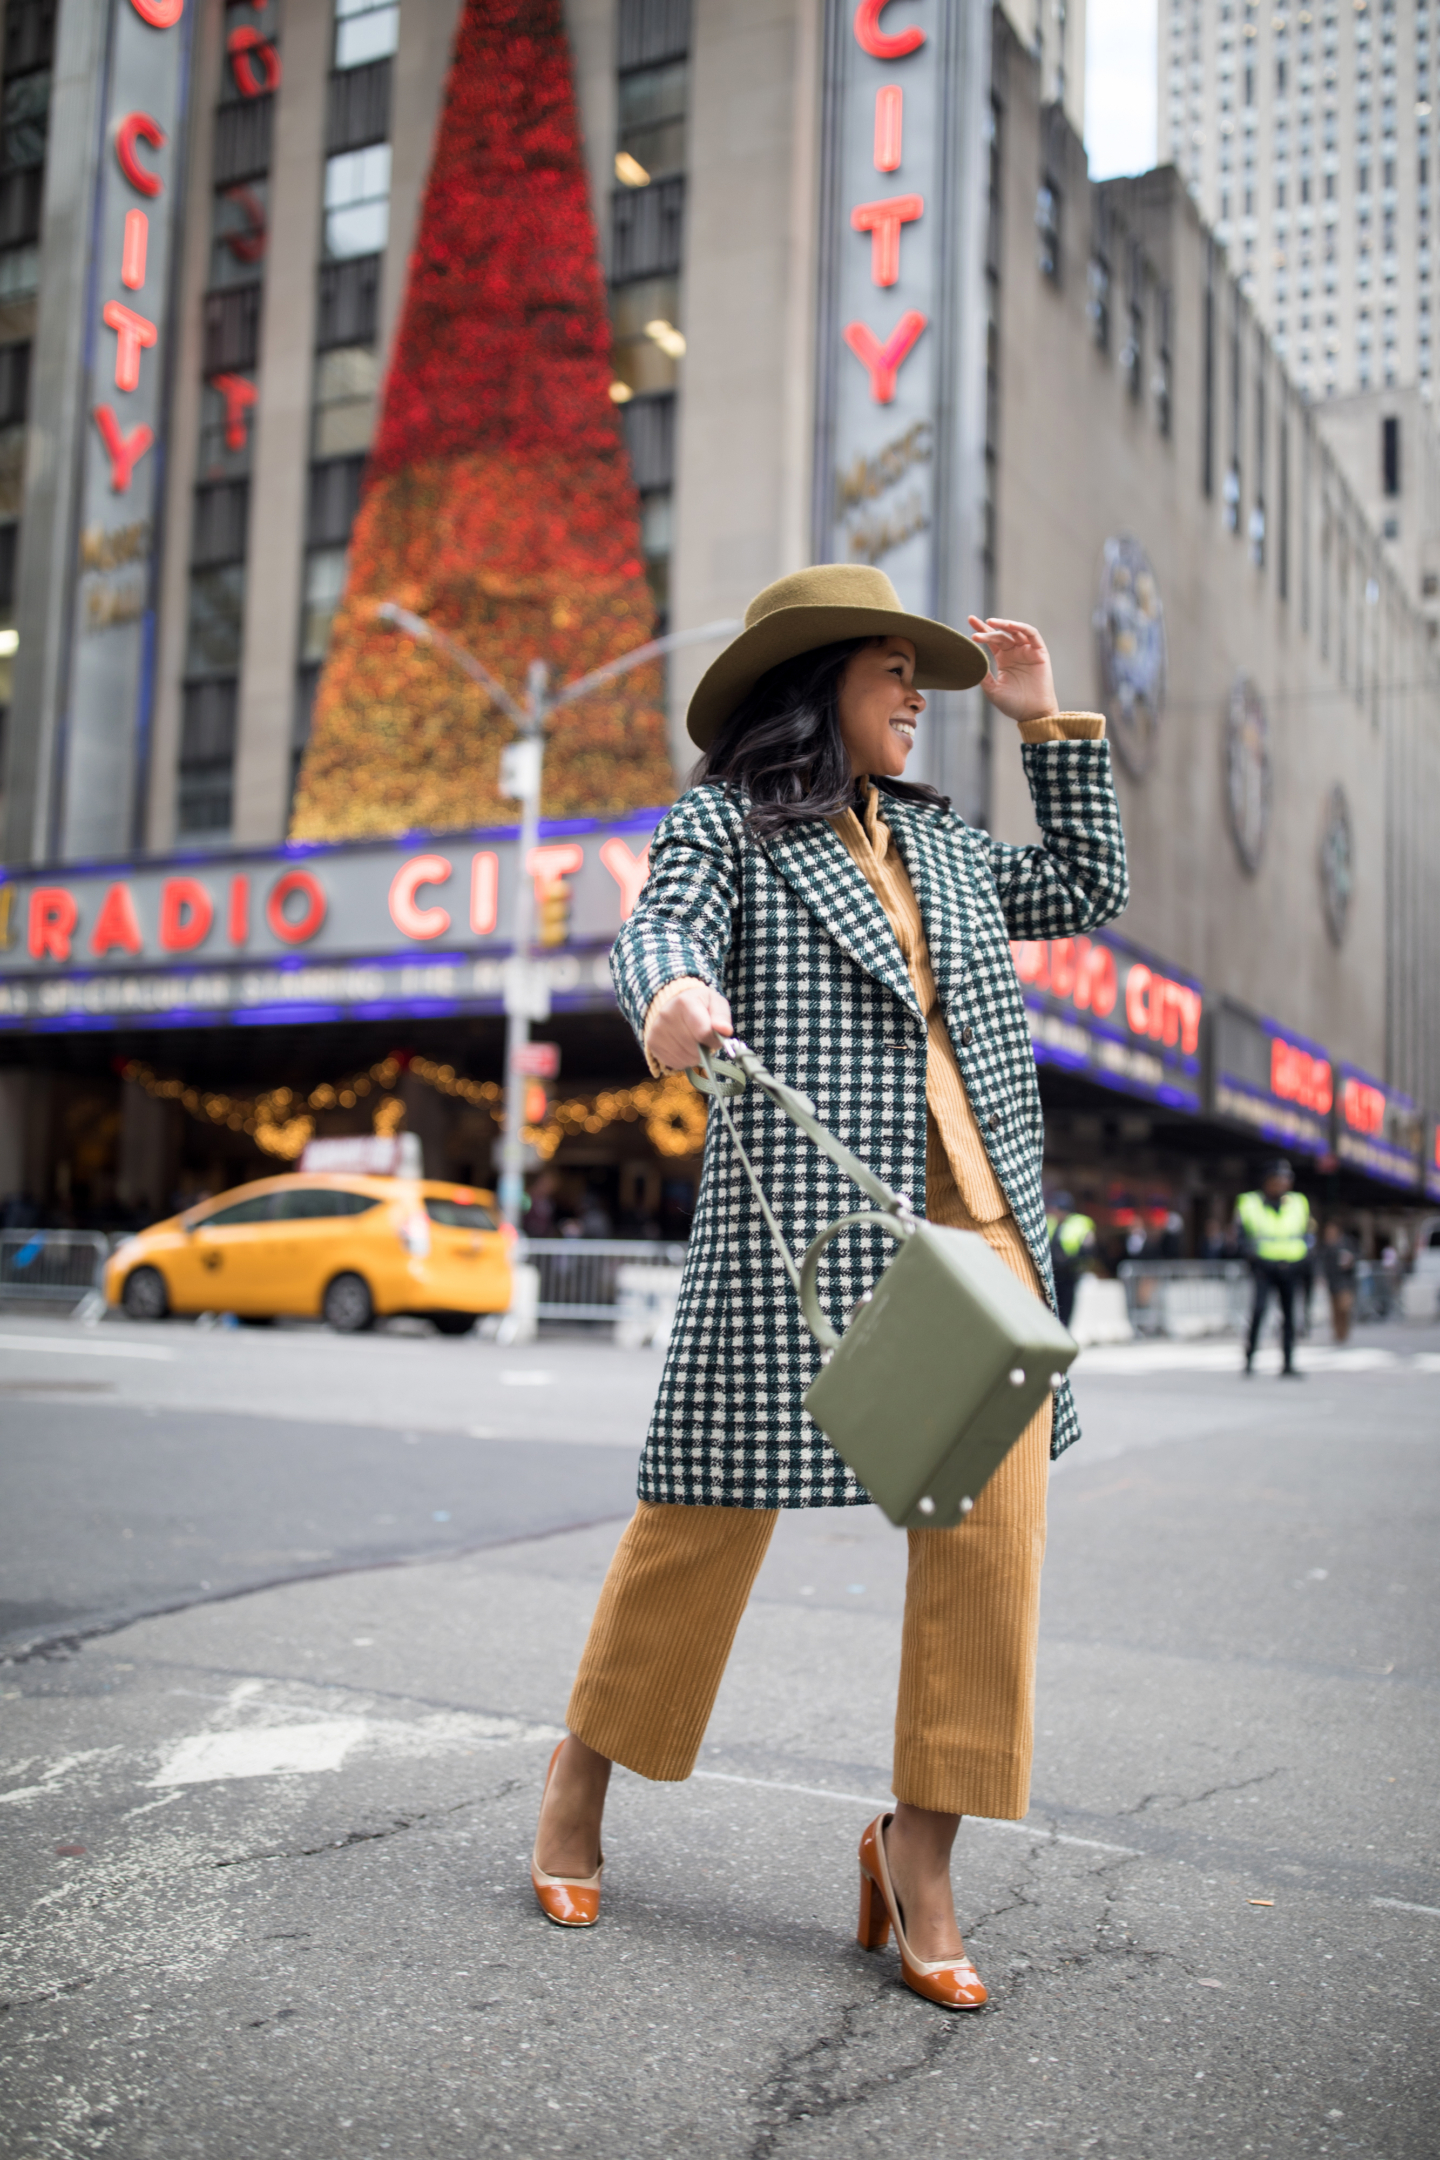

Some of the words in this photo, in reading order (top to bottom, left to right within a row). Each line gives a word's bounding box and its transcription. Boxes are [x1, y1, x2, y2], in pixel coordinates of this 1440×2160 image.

[95, 111, 167, 492] CITY
[843, 0, 928, 404] CITY
[27, 868, 327, 964] RADIO
[388, 838, 652, 940] CITY
[1125, 962, 1202, 1056] CITY
